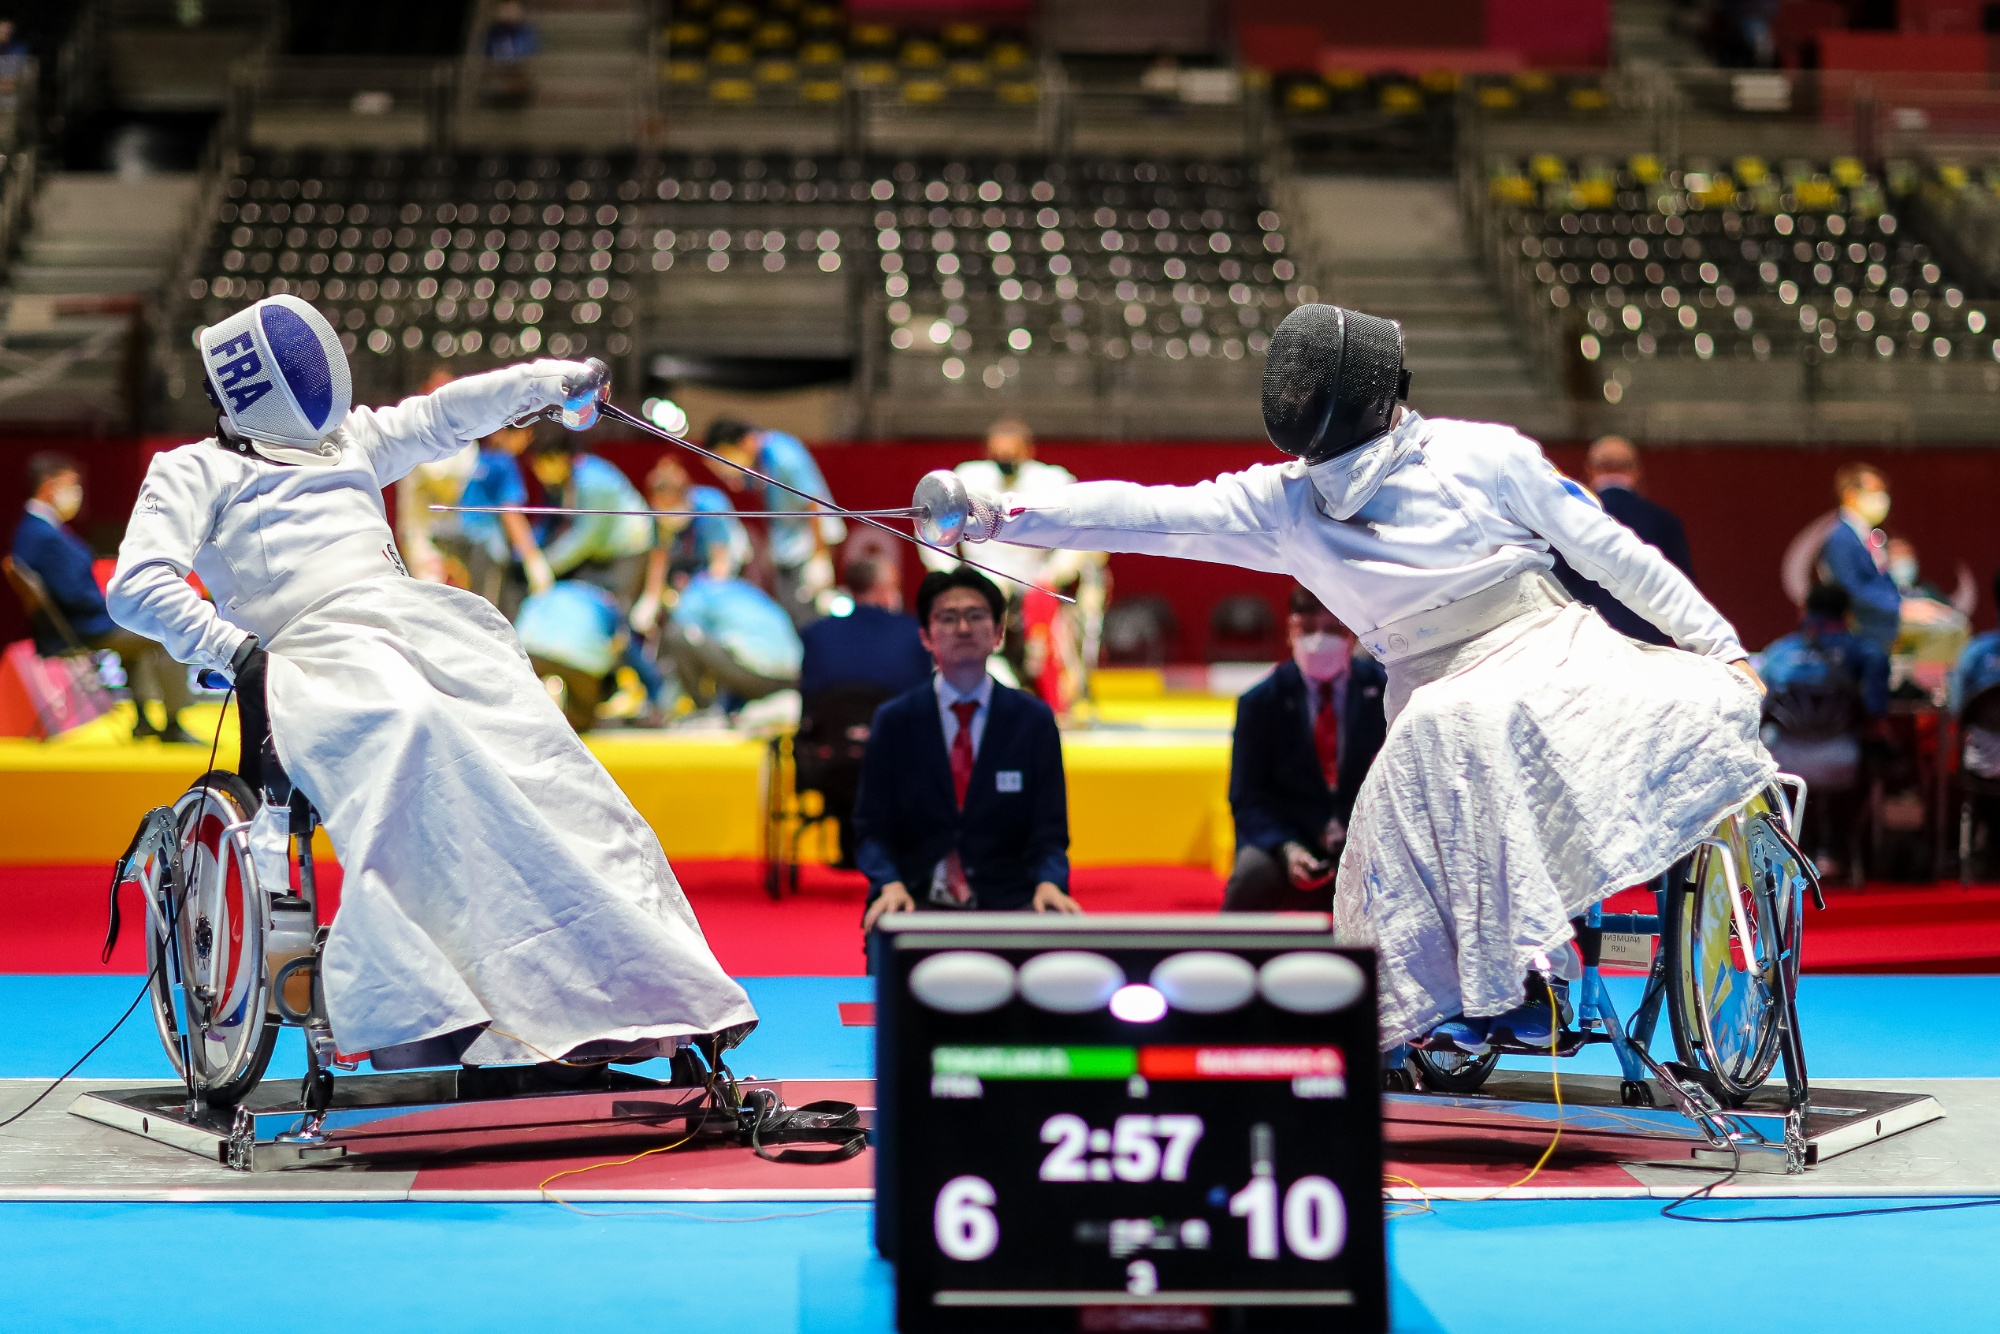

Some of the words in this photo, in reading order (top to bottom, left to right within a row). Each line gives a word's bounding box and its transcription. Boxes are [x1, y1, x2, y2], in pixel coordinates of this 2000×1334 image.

[210, 330, 273, 415] FRA
[1039, 1113, 1204, 1182] 2:57
[933, 1175, 999, 1261] 6
[1229, 1175, 1347, 1261] 10
[1126, 1260, 1158, 1296] 3
